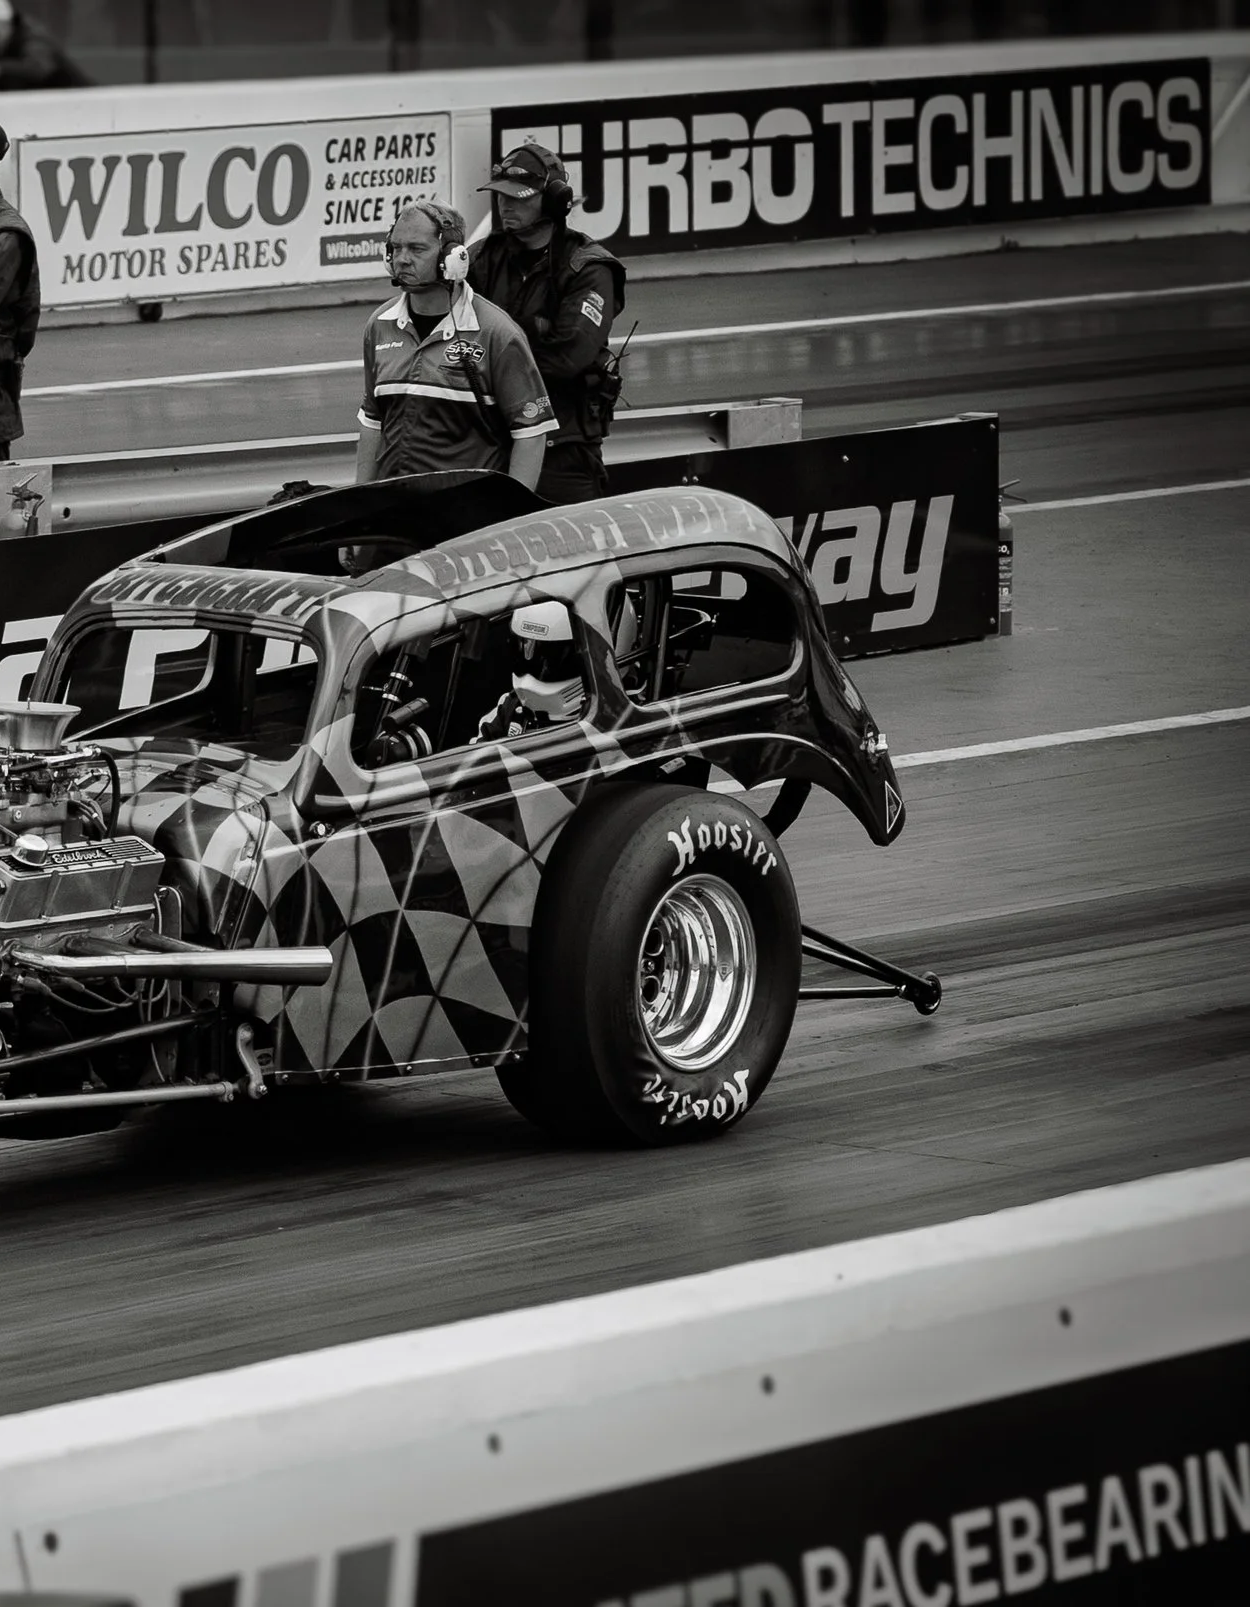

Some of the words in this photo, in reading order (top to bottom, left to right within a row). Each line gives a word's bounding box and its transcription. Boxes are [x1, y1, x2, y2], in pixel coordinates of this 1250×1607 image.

[325, 137, 366, 163] CAR
[374, 132, 436, 160] PARTS
[823, 76, 1203, 218] TECHNICS
[36, 144, 311, 243] WILCO
[325, 173, 336, 191] &
[340, 166, 436, 189] ACCESSORIES
[324, 197, 385, 225] SINCE
[61, 247, 167, 284] MOTOR
[177, 238, 288, 273] SPARES
[52, 849, 109, 864] Edelbrock
[667, 815, 778, 876] Hoosier
